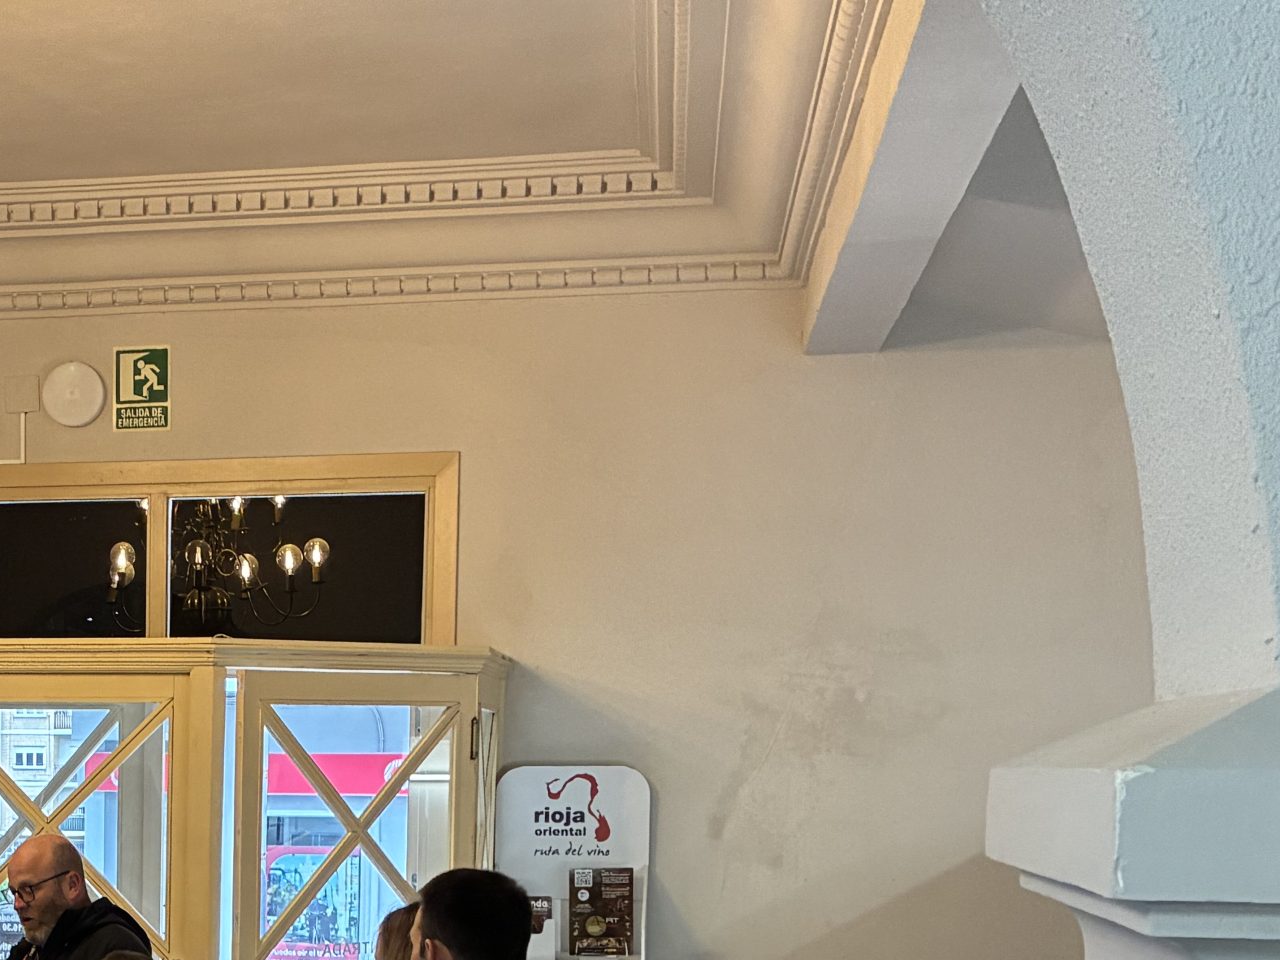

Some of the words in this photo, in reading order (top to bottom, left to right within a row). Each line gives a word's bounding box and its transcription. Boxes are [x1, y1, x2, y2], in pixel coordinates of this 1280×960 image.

[121, 408, 151, 418] SALIDA
[152, 407, 162, 417] DE
[118, 416, 166, 428] EMERGENCIA
[534, 806, 586, 827] rioja
[534, 826, 587, 837] oriental
[534, 846, 560, 857] ruta
[564, 841, 583, 857] del
[586, 845, 610, 857] vino
